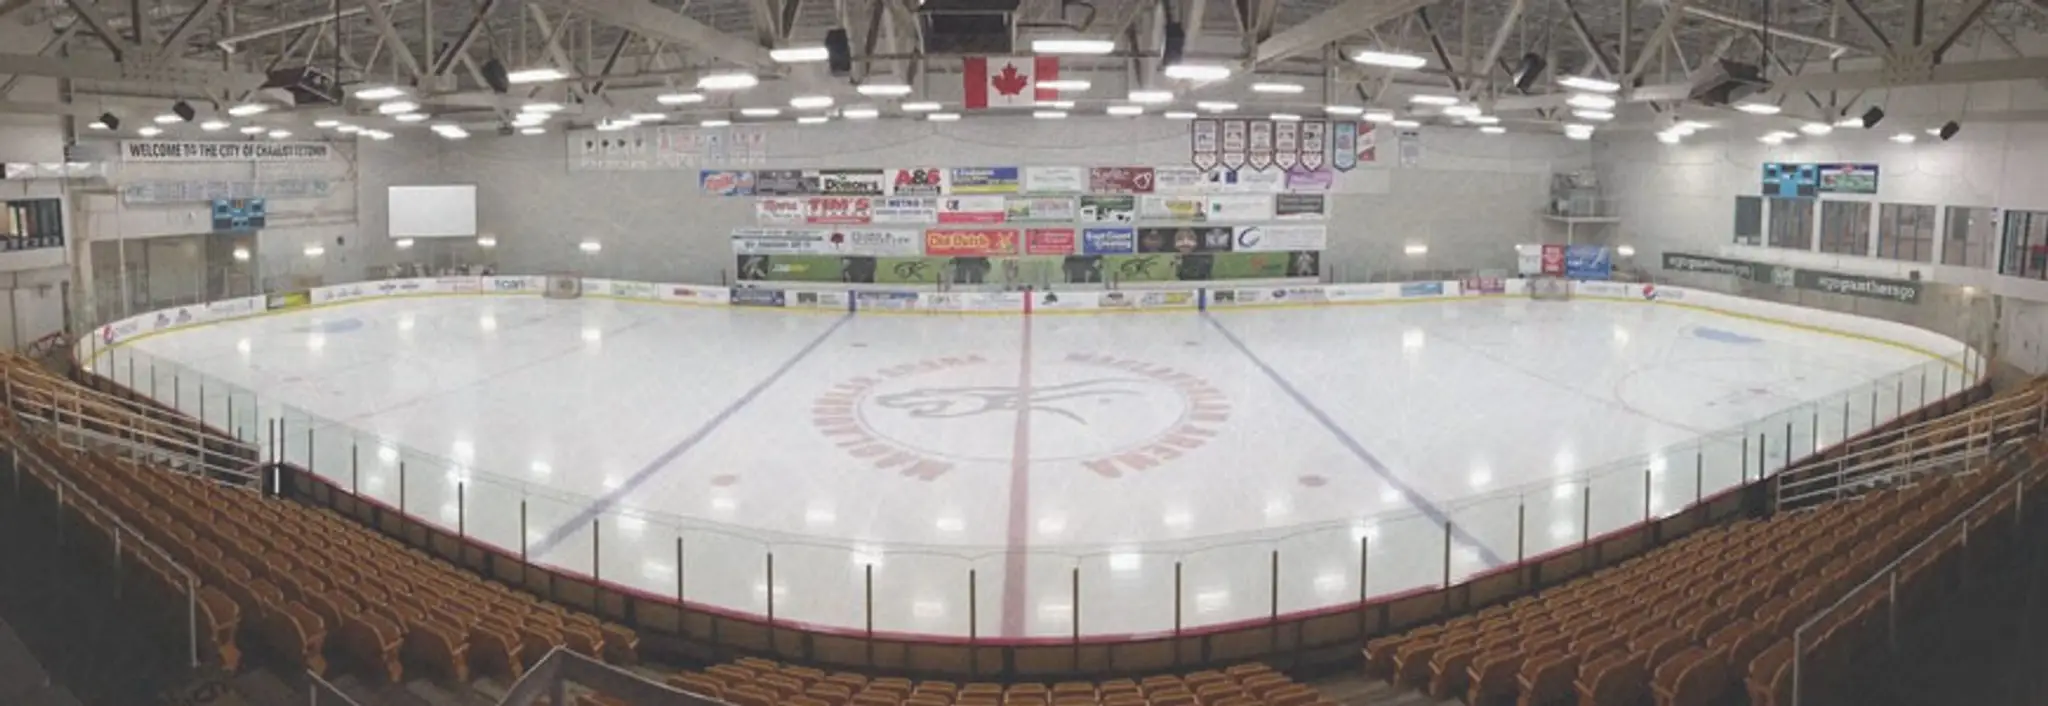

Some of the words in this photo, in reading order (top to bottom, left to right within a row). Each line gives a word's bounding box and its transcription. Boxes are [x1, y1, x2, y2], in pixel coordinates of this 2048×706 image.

[130, 143, 181, 157] WELCOME
[184, 144, 197, 157] TO
[199, 144, 217, 157] THE
[219, 144, 240, 157] CITY
[243, 144, 255, 157] OF
